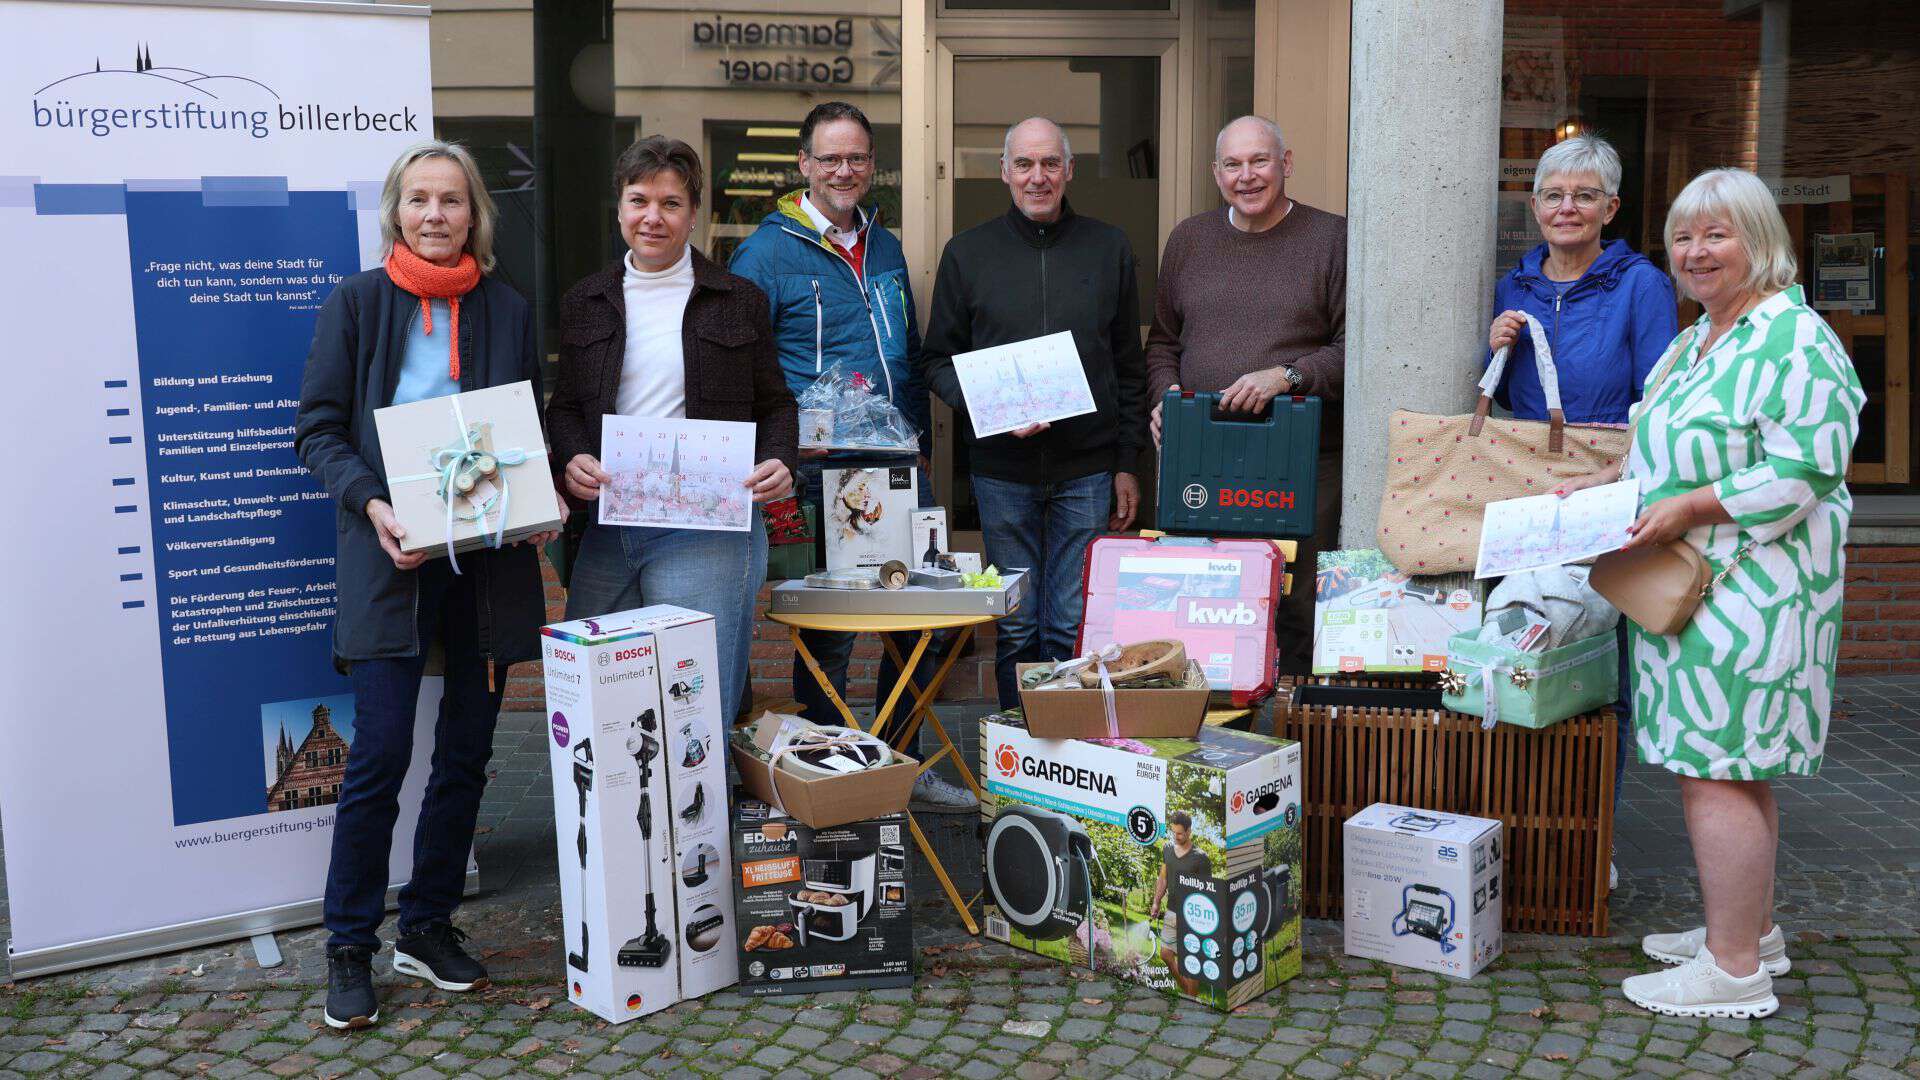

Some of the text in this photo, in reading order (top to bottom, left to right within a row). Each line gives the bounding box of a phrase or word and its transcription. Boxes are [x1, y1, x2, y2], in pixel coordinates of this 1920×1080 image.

[33, 99, 419, 139] bürgerstiftung billerbeck
[1794, 184, 1831, 196] Stadt
[144, 258, 324, 273] „Frage nicht, was deine Stadt für
[156, 273, 344, 288] dich tun kann, sondern was du für
[189, 293, 220, 304] deine
[223, 291, 252, 302] Stadt
[254, 292, 273, 302] tun
[153, 373, 273, 387] Bildung und Erziehung
[155, 404, 200, 416] Jugend-,
[203, 401, 252, 412] Familien-
[254, 401, 274, 410] und
[157, 429, 234, 443] Unterstützung
[159, 445, 204, 456] Familien
[207, 443, 227, 453] und
[161, 465, 311, 484] Kultur, Kunst und Denkmalp
[163, 498, 231, 511] Klimaschutz,
[233, 495, 277, 506] Umwelt-
[279, 493, 299, 502] und
[1218, 488, 1296, 510] BOSCH
[164, 508, 283, 525] und Landschaftspflege
[165, 536, 276, 551] Völkerverständigung
[167, 557, 335, 580] Sport und Gesundheitsförderung
[1208, 562, 1237, 572] kwb
[170, 595, 188, 605] Die
[190, 589, 245, 604] Förderung
[247, 588, 265, 598] des
[268, 586, 302, 596] Feuer-,
[171, 603, 242, 618] Katastrophen
[244, 601, 265, 611] und
[267, 596, 331, 609] Zivilschutzes
[1187, 600, 1257, 625] kwb
[172, 622, 190, 632] der
[192, 614, 277, 631] Unfallverhütung
[173, 622, 327, 645] der Rettung aus Lebensgefahr
[554, 648, 576, 663] BOSCH
[615, 645, 652, 662] BOSCH
[576, 674, 581, 685] 7
[598, 666, 654, 685] Unlimited 7
[1136, 761, 1161, 774] MADE IN
[1022, 755, 1118, 797] GARDENA
[1136, 769, 1161, 782] EUROPE
[743, 830, 798, 844] EDA
[748, 842, 791, 854] zuhause
[751, 868, 793, 882] FRITTEUSE
[1179, 875, 1217, 892] RollUp XL
[1229, 873, 1256, 893] RollUp XL
[1186, 902, 1215, 921] 35 m
[1234, 902, 1255, 920] 35 m
[1141, 965, 1169, 978] Always
[1146, 978, 1176, 990] Ready
